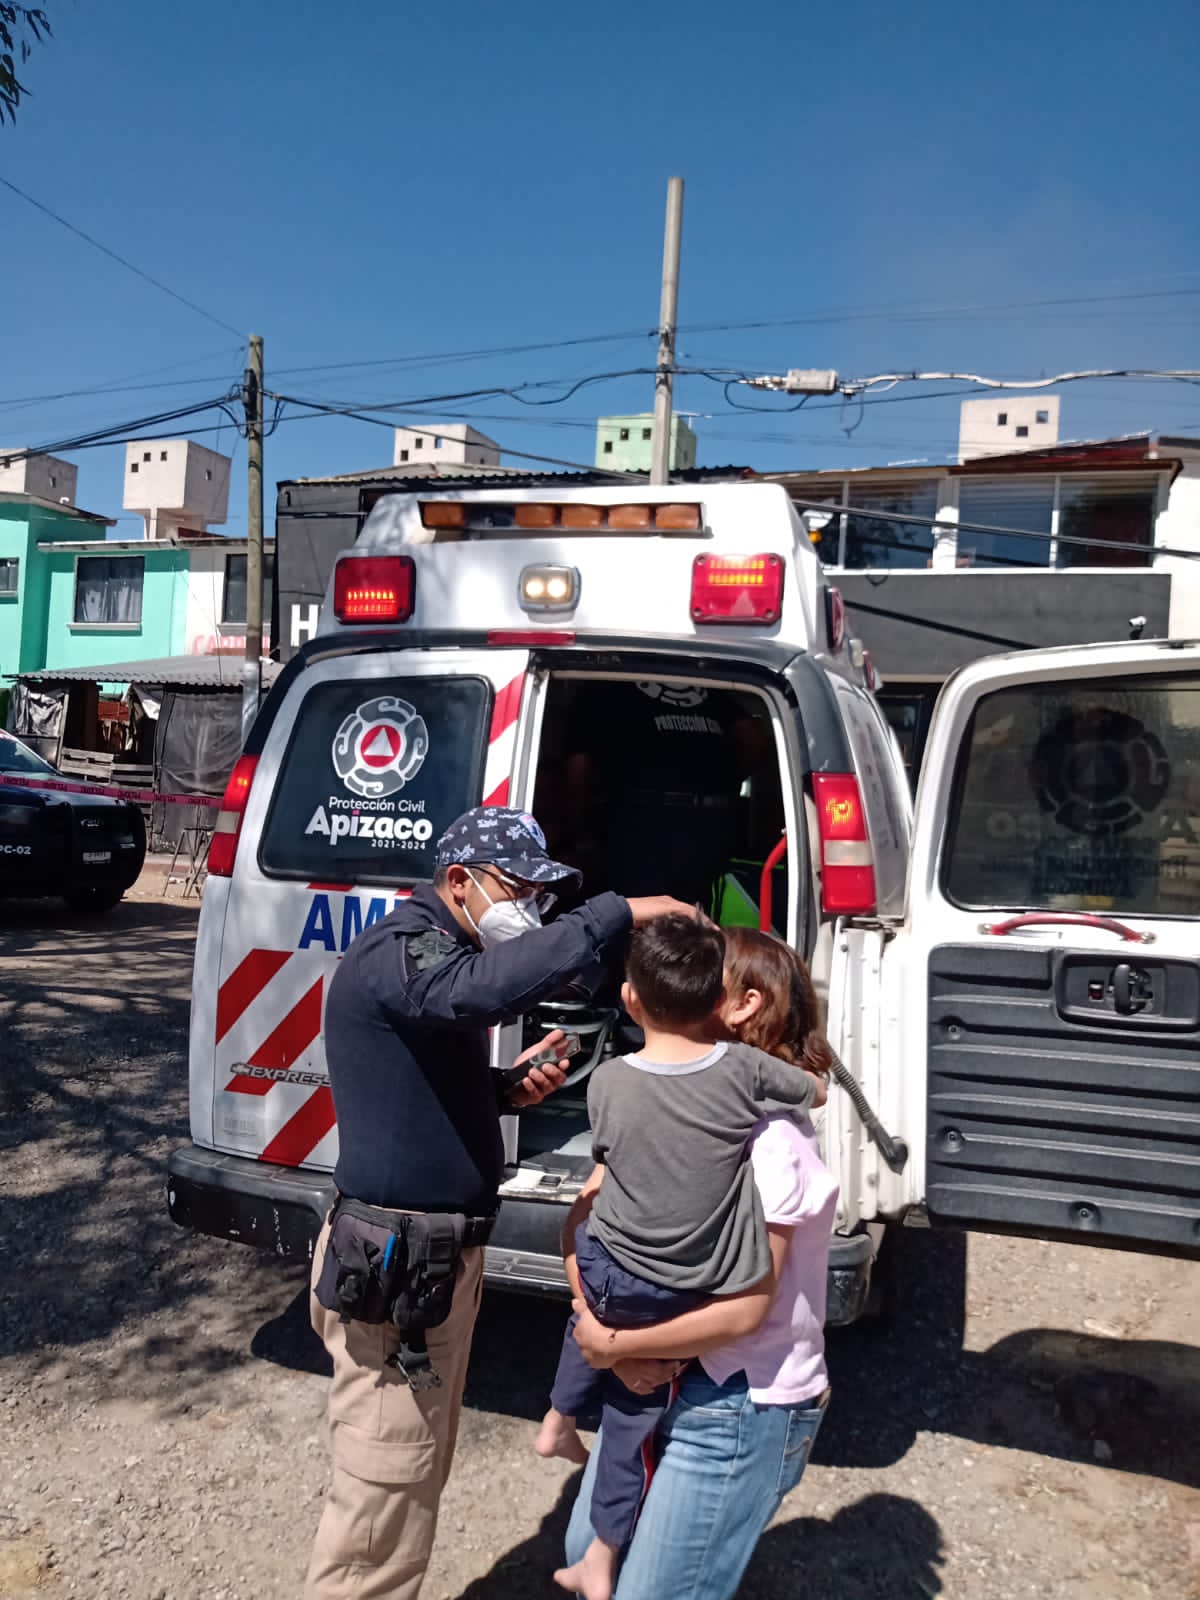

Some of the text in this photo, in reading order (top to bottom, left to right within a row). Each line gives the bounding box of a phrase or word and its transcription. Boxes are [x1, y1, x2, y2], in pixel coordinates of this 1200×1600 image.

[290, 604, 319, 647] H
[328, 796, 425, 813] Protección Civil
[304, 805, 433, 846] Apizaco
[371, 839, 426, 850] 2021-2024
[298, 894, 405, 952] AM
